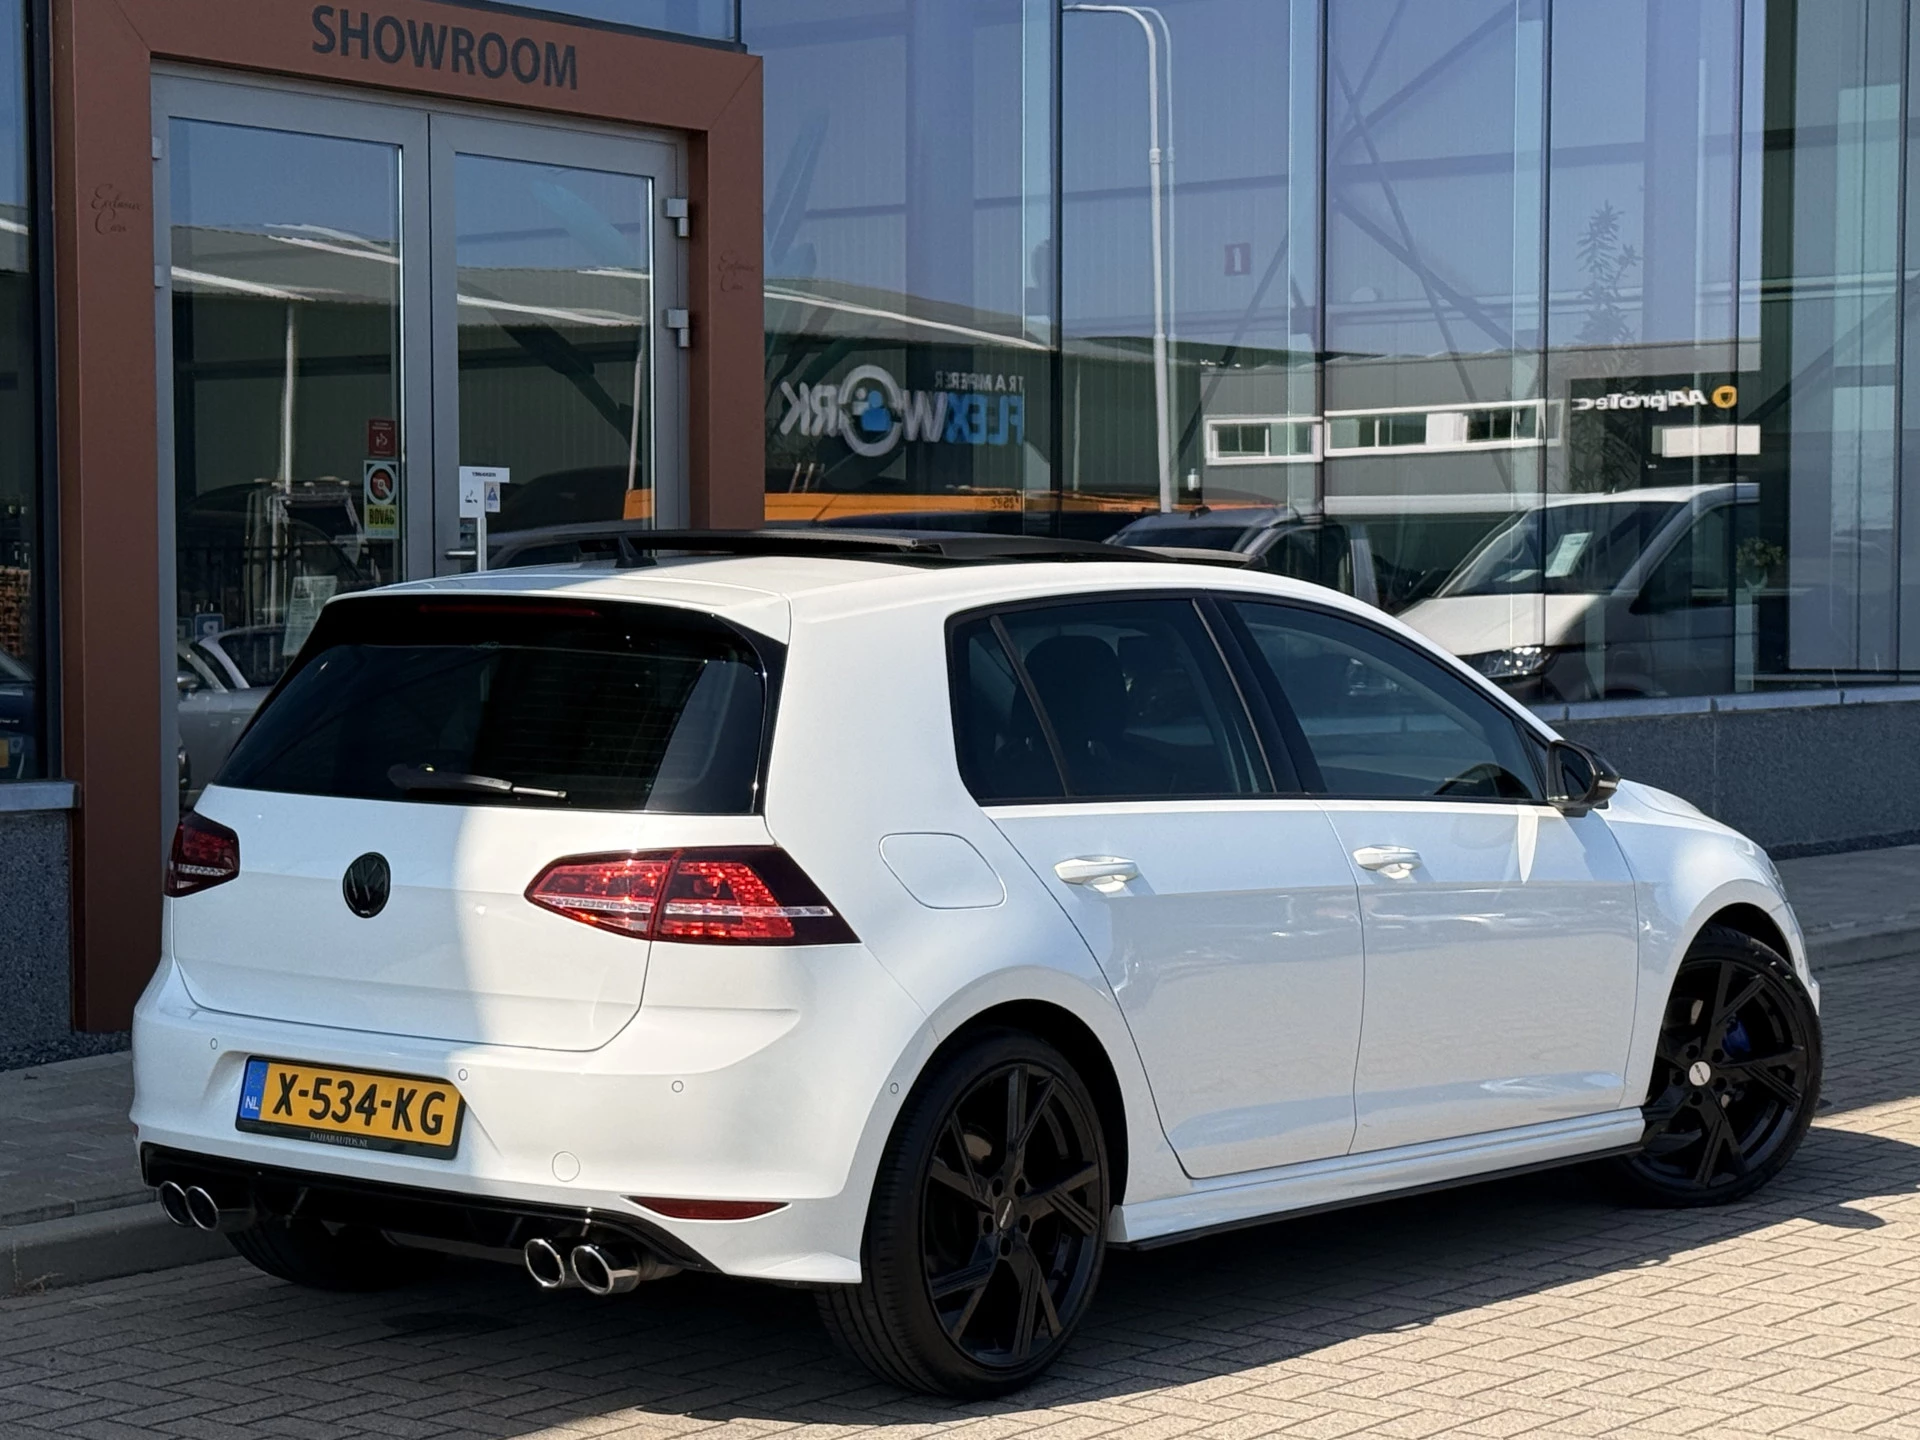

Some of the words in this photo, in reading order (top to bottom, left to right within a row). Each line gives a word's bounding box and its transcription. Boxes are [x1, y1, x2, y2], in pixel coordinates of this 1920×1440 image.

[311, 5, 578, 91] SHOWROOM
[244, 1095, 260, 1111] NL
[272, 1072, 446, 1136] X-534-KG
